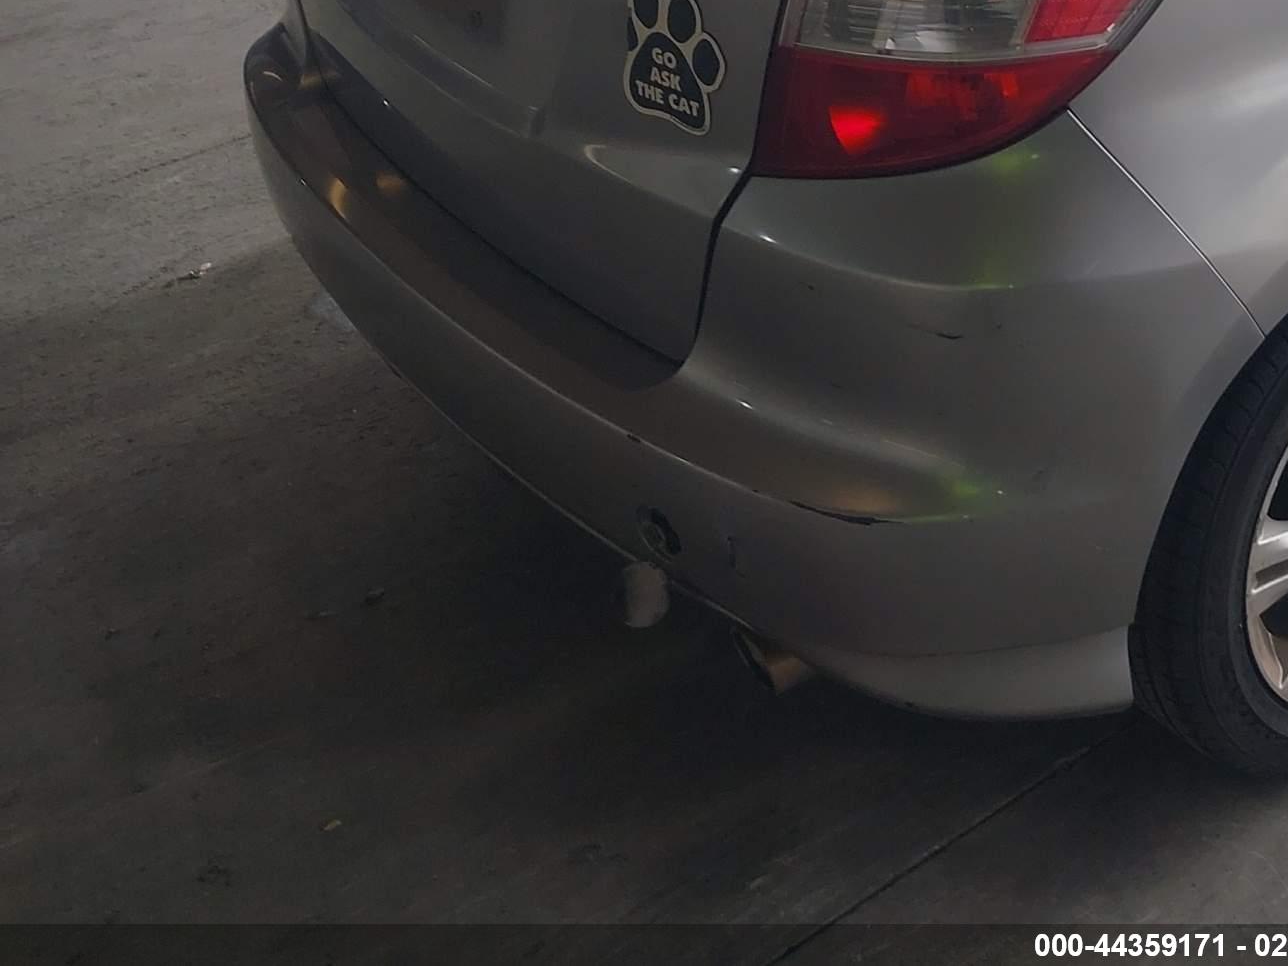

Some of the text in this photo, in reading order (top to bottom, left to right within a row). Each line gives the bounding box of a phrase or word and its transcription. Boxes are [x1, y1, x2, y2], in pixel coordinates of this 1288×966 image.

[652, 47, 677, 69] GO
[650, 66, 682, 92] ASK
[635, 80, 700, 117] THE CAT
